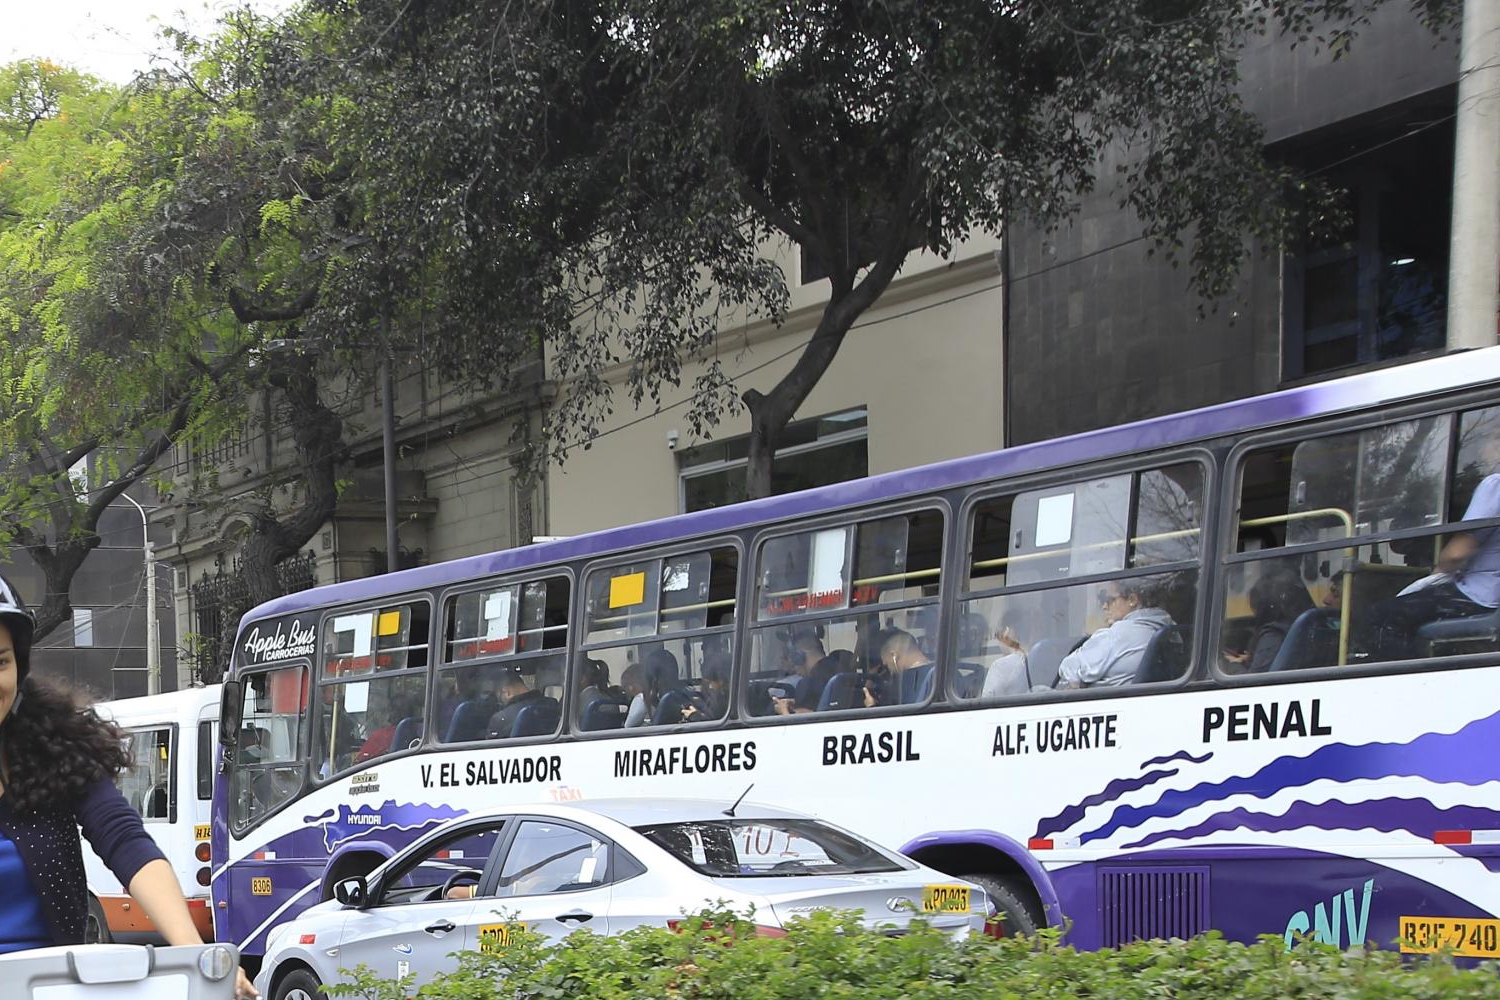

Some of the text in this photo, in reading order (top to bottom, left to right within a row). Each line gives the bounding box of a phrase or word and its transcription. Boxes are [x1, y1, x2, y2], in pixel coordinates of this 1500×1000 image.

[245, 619, 316, 662] Apple Bus
[266, 644, 315, 661] CARROCERIAS
[421, 699, 1332, 788] V. EL SALVADOR MIRAFLORES BRASIL ALF. UGARTE PENAL
[549, 788, 582, 801] TAXI
[347, 814, 381, 825] HYUNDAI
[253, 880, 272, 893] 8306
